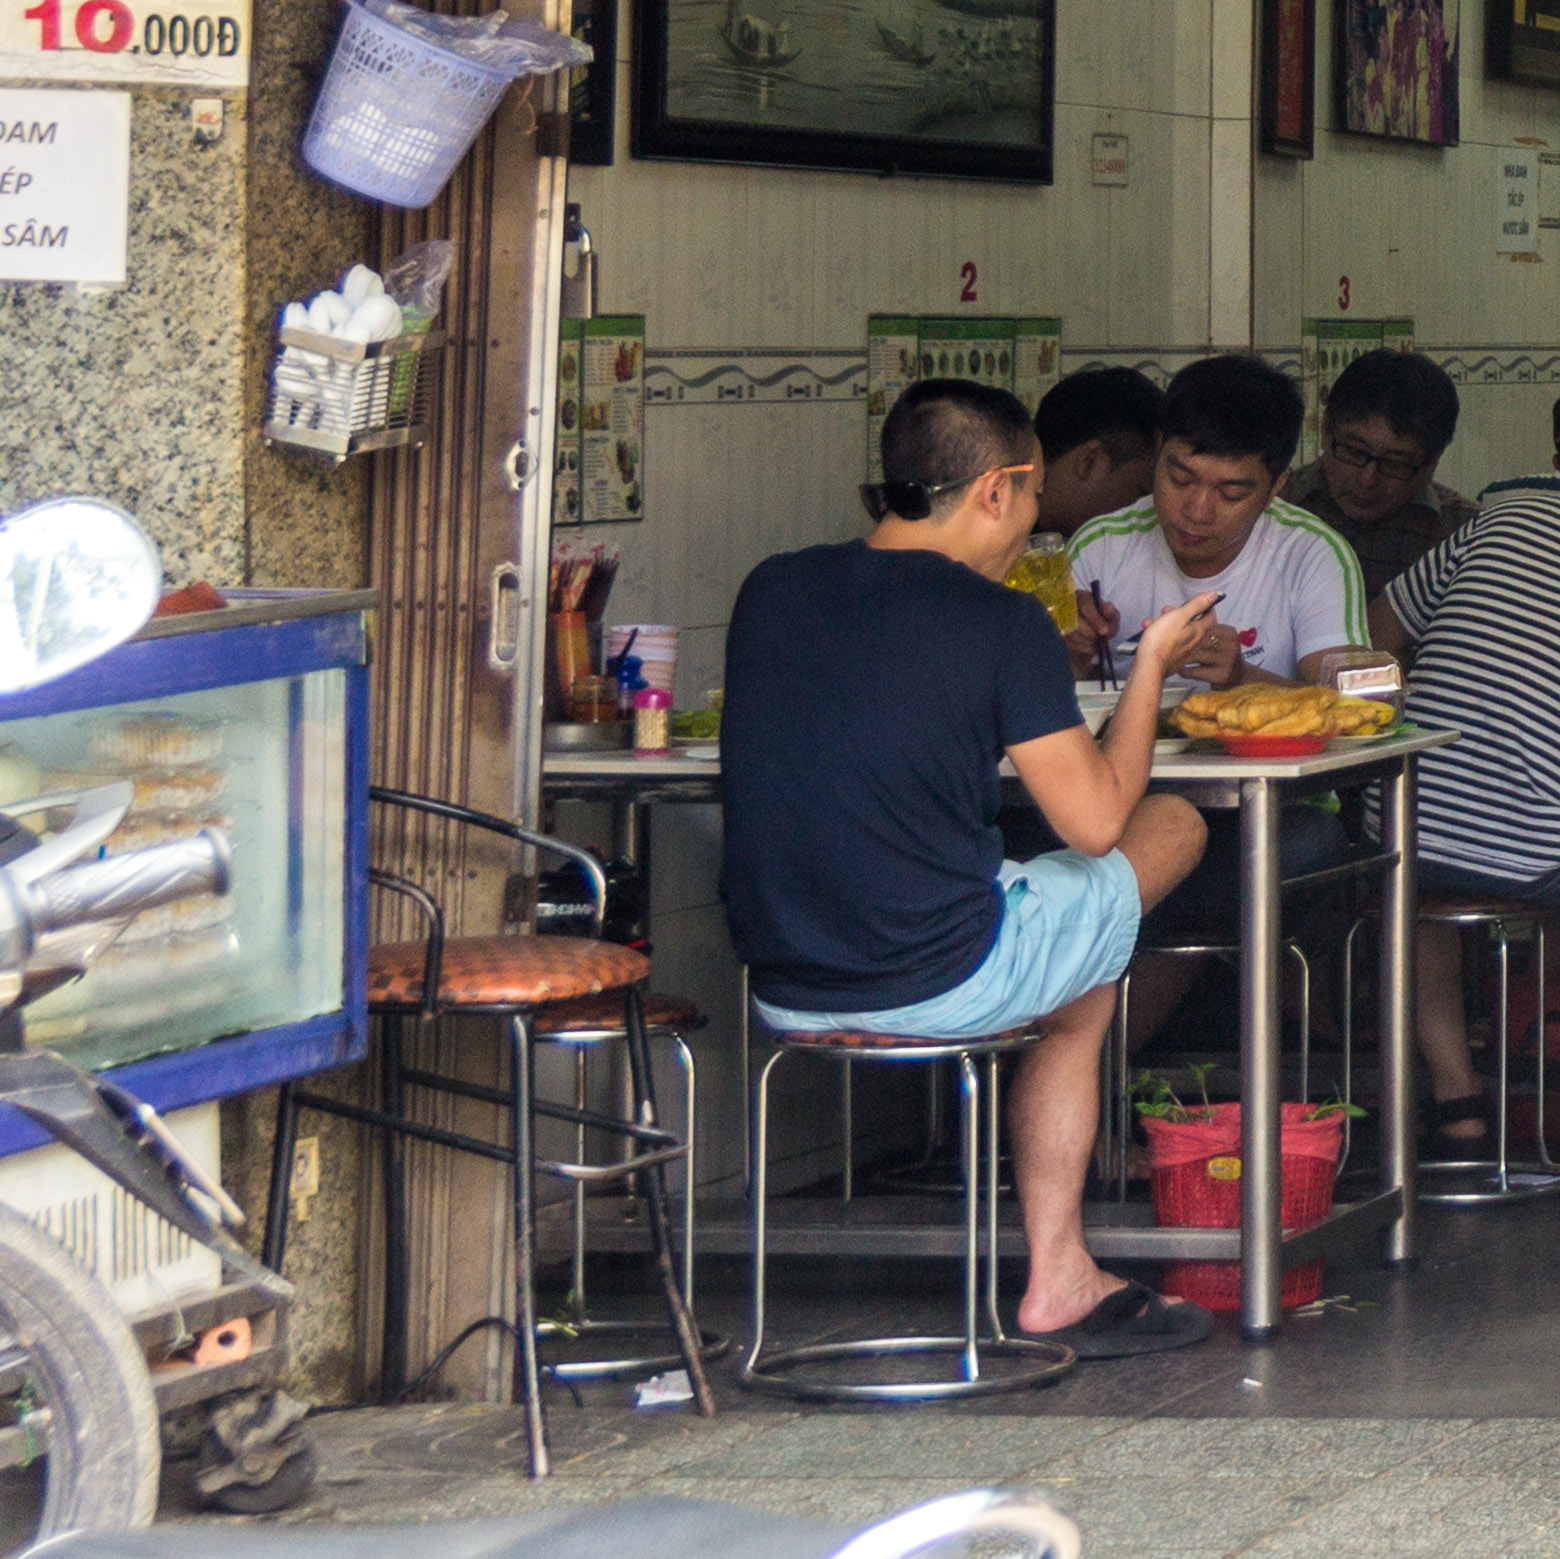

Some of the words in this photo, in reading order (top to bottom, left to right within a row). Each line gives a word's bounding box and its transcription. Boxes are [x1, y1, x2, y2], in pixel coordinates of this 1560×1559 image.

[2, 218, 69, 247] SÂM
[960, 262, 978, 302] 2
[1338, 276, 1351, 311] 3
